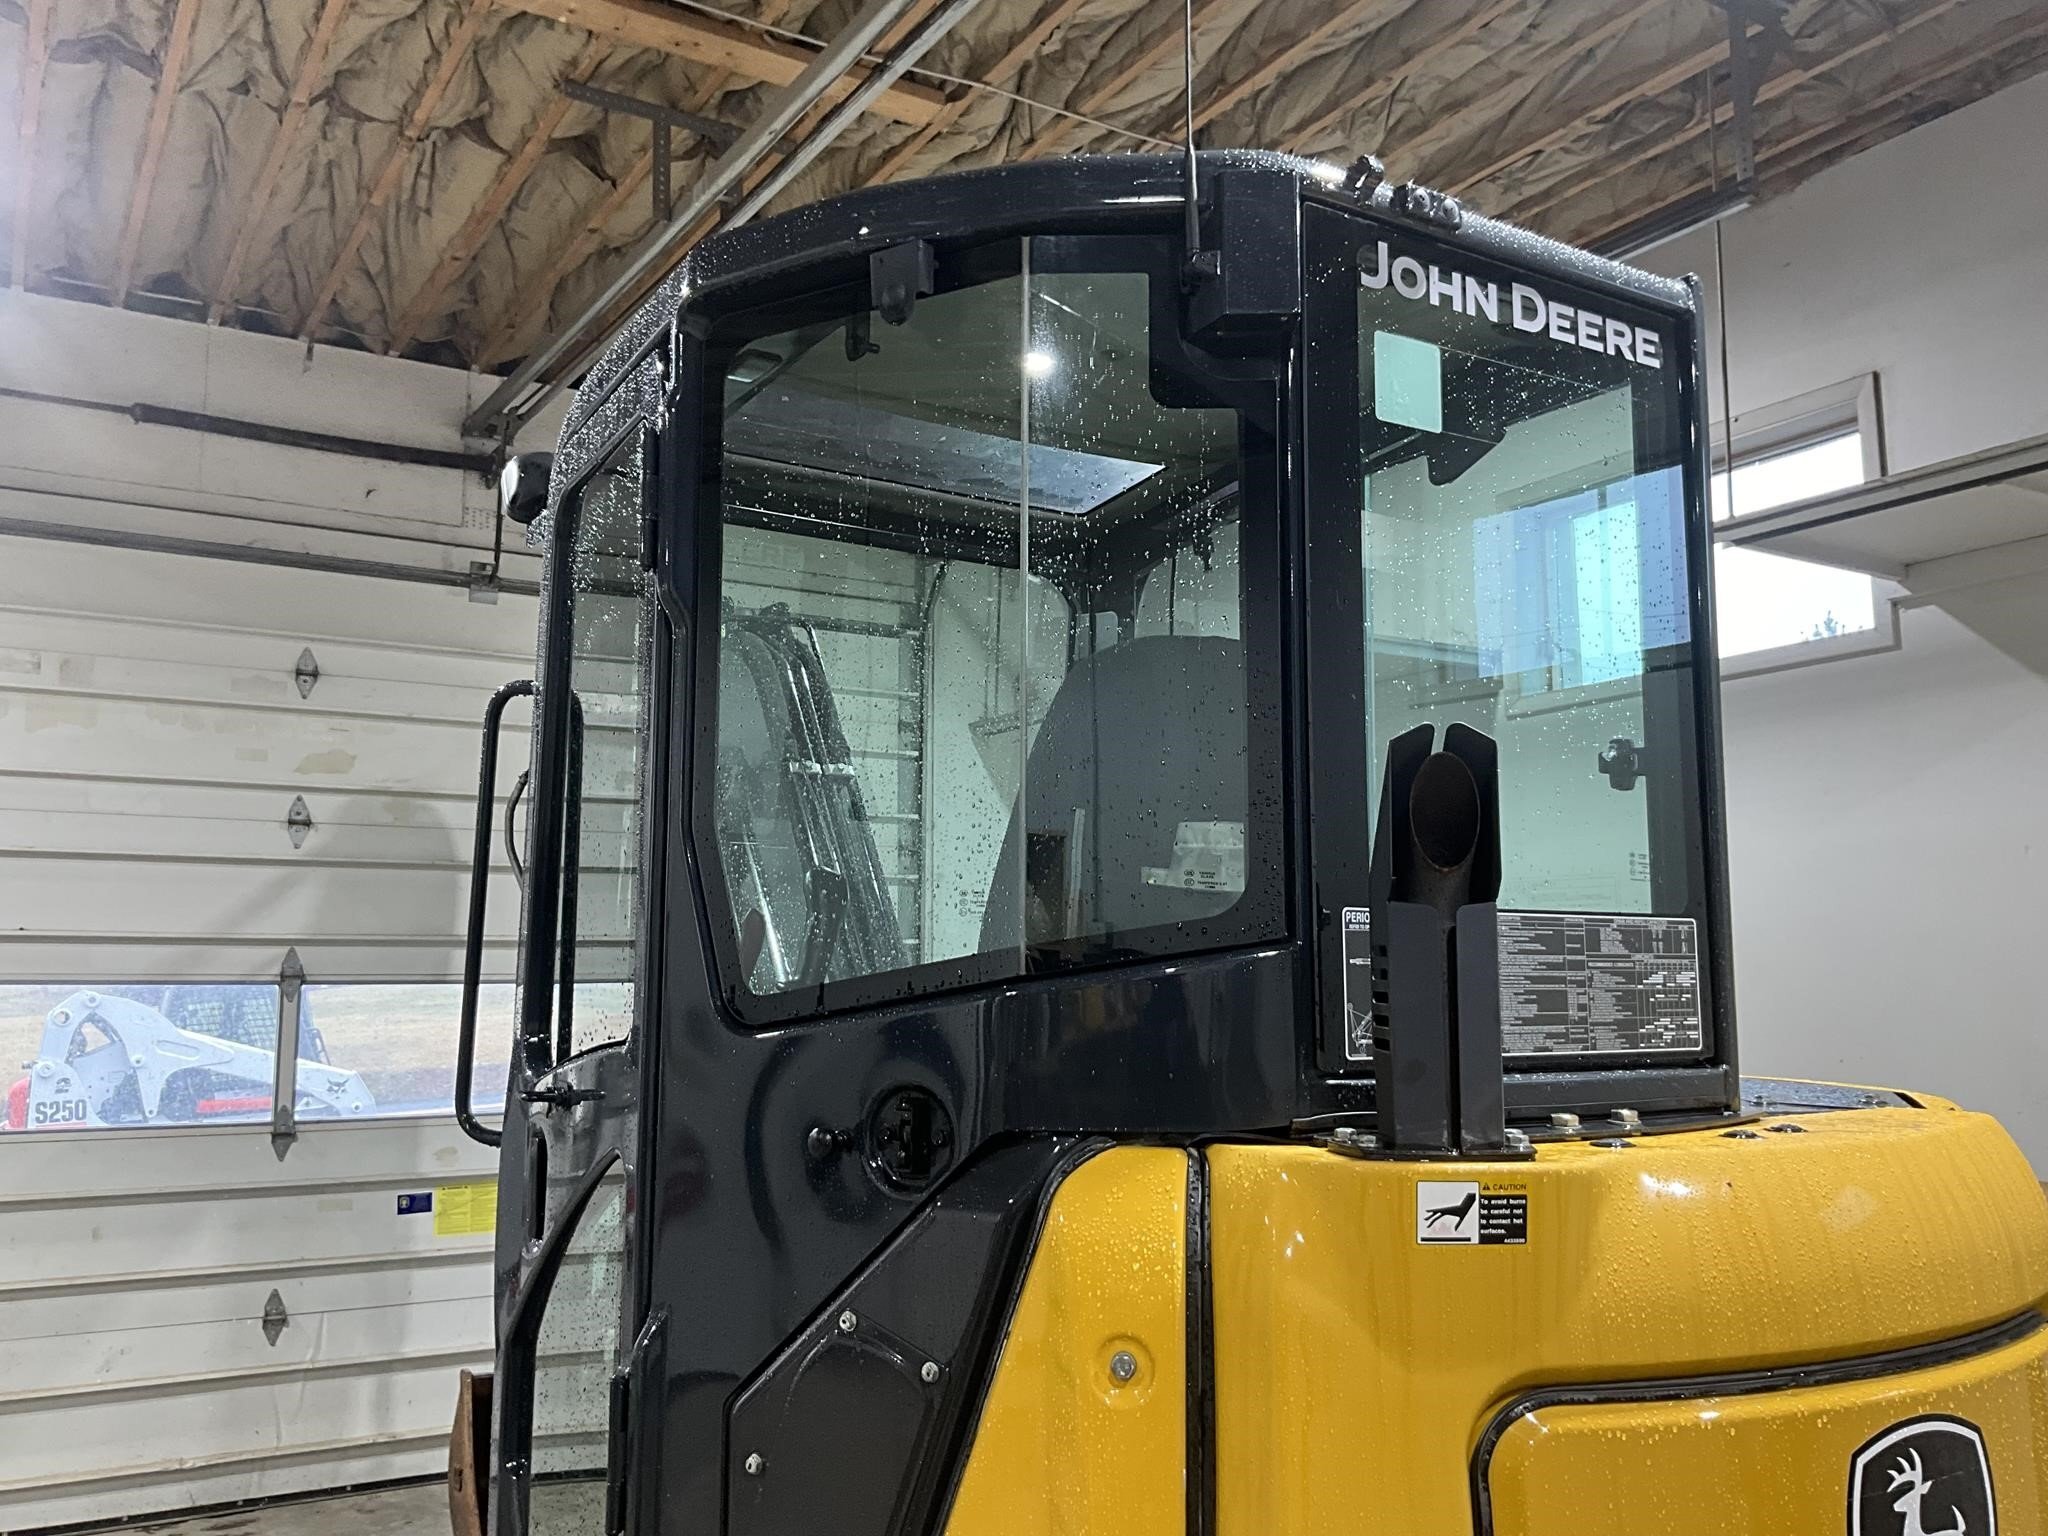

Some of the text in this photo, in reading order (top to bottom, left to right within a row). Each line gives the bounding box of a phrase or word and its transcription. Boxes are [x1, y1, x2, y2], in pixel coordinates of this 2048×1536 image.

[1360, 241, 1661, 369] JOHN DEERE
[35, 1098, 87, 1124] S250
